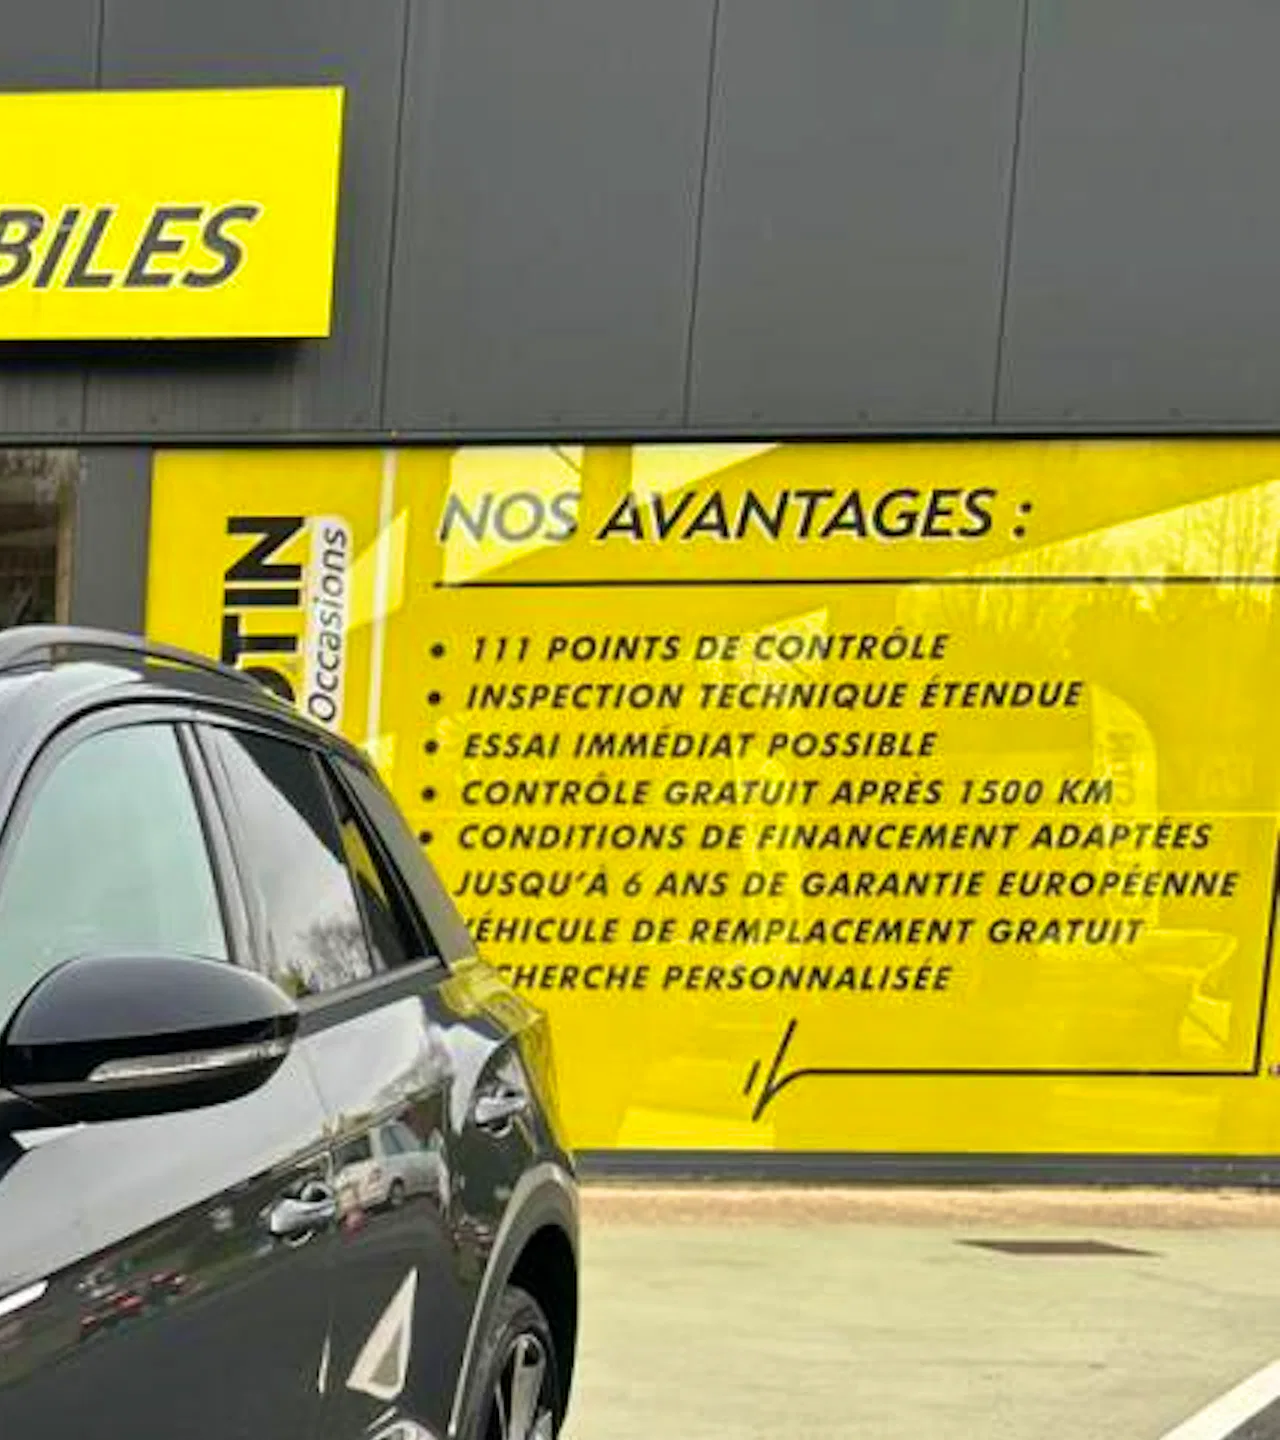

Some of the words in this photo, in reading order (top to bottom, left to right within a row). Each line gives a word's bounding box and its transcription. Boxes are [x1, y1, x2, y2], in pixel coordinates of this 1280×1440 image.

[438, 491, 580, 542] NOS
[597, 488, 997, 540] AVANTAGES
[307, 526, 348, 724] Occasions
[474, 637, 531, 662] 111
[547, 636, 681, 662] POINTS
[695, 636, 740, 661] DE
[754, 626, 950, 661] CONTRÔLE
[466, 684, 685, 710] INSPECTION
[700, 683, 906, 710] TECHNIQUE
[920, 674, 1083, 708] ÉTENDUE
[463, 732, 561, 759] ESSAI
[574, 724, 756, 759] IMMÉDIAT
[767, 732, 938, 758] POSSIBLE
[461, 772, 651, 805] CONTRÔLE
[664, 780, 820, 805] GRATUIT
[831, 769, 943, 806] APRÈS
[960, 779, 1045, 805] 1500
[1058, 779, 1115, 805] KM
[458, 824, 687, 850] CONDITIONS
[700, 825, 745, 850] DE
[756, 824, 1021, 850] FINANCEMENT
[1030, 816, 1213, 850] ADAPTÉES
[623, 872, 643, 897] 6
[655, 872, 730, 897] ANS
[742, 872, 788, 897] DE
[801, 871, 985, 897] GARANTIE
[997, 862, 1240, 897] EUROPÉENNE
[631, 919, 677, 942] DE
[688, 918, 976, 945] REMPLACEMENT
[988, 918, 1145, 944] GRATUIT
[661, 963, 952, 991] PERSONNALISÉE
